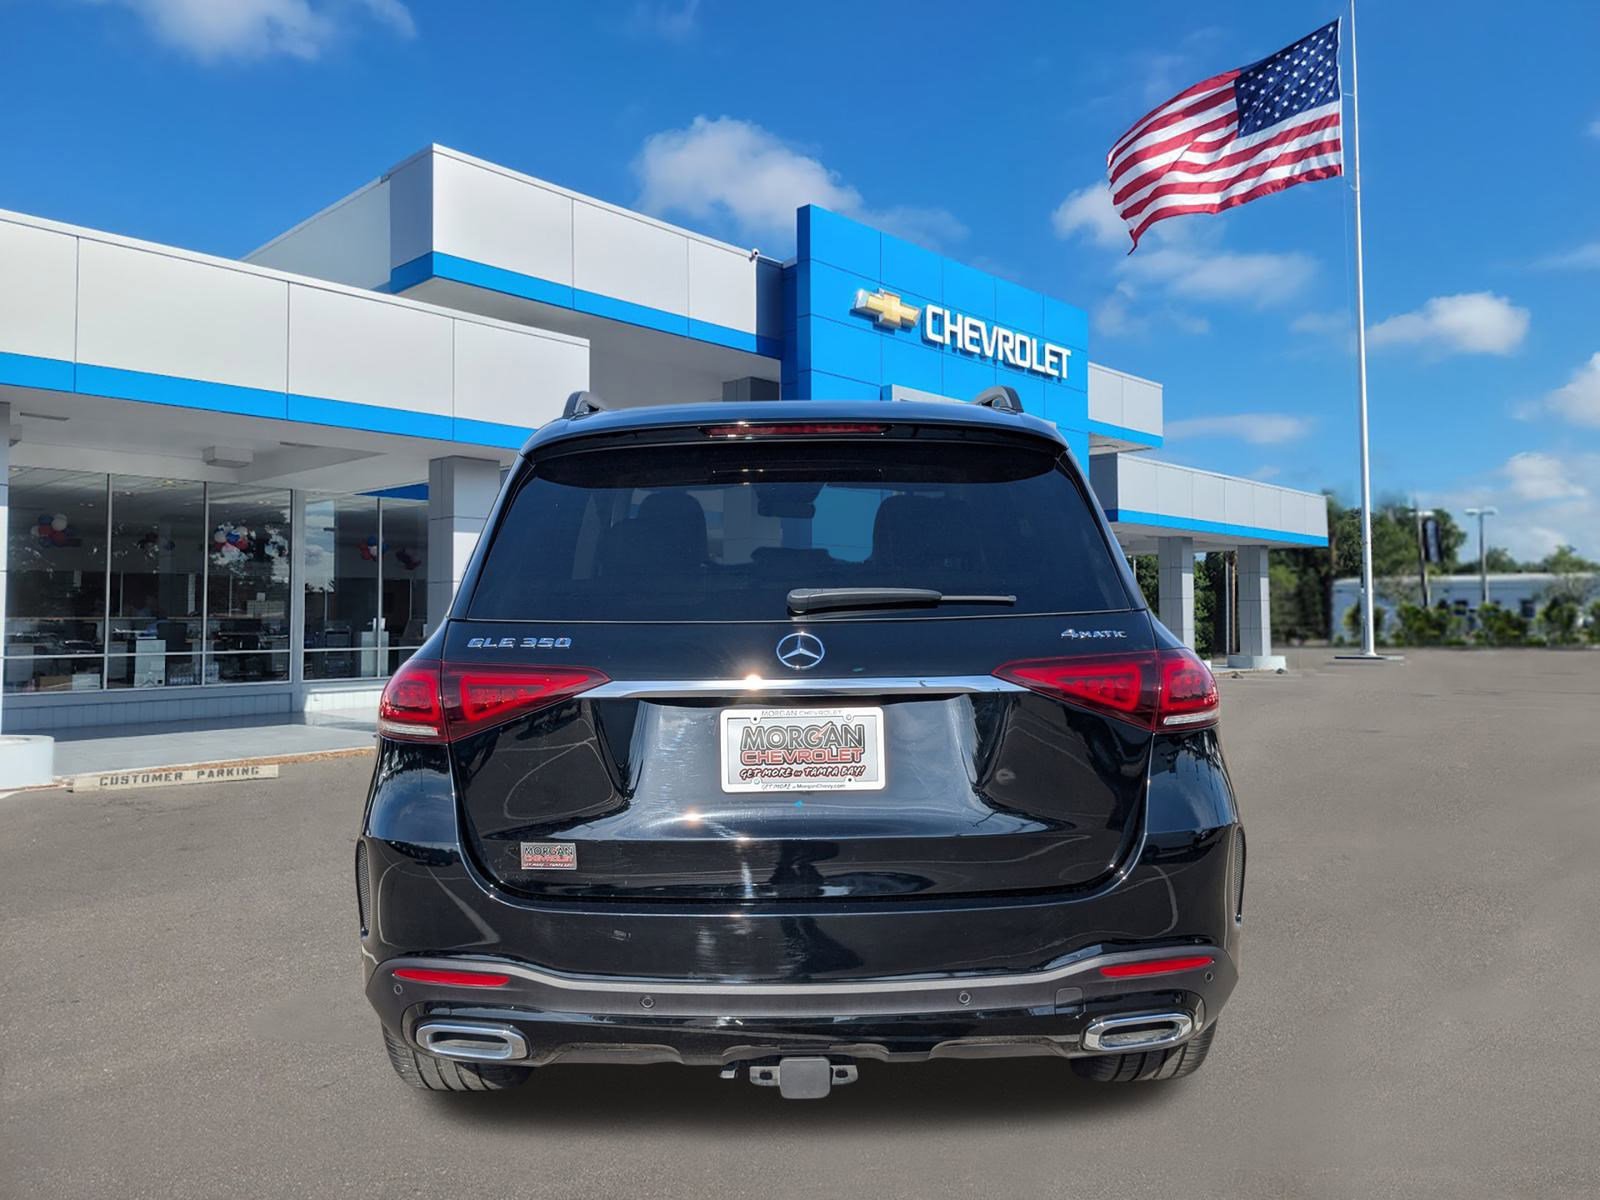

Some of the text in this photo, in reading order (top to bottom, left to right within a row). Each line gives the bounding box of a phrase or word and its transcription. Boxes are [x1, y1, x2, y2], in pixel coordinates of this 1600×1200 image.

[924, 303, 1072, 379] CHEVROLET
[467, 637, 572, 648] GLE 350
[741, 721, 865, 751] MORGAN
[741, 748, 864, 765] CHEVROLET
[99, 766, 260, 787] CUSTOMER PARKING
[740, 768, 761, 780] GET
[761, 767, 793, 778] MORE
[804, 766, 839, 777] TAMPA
